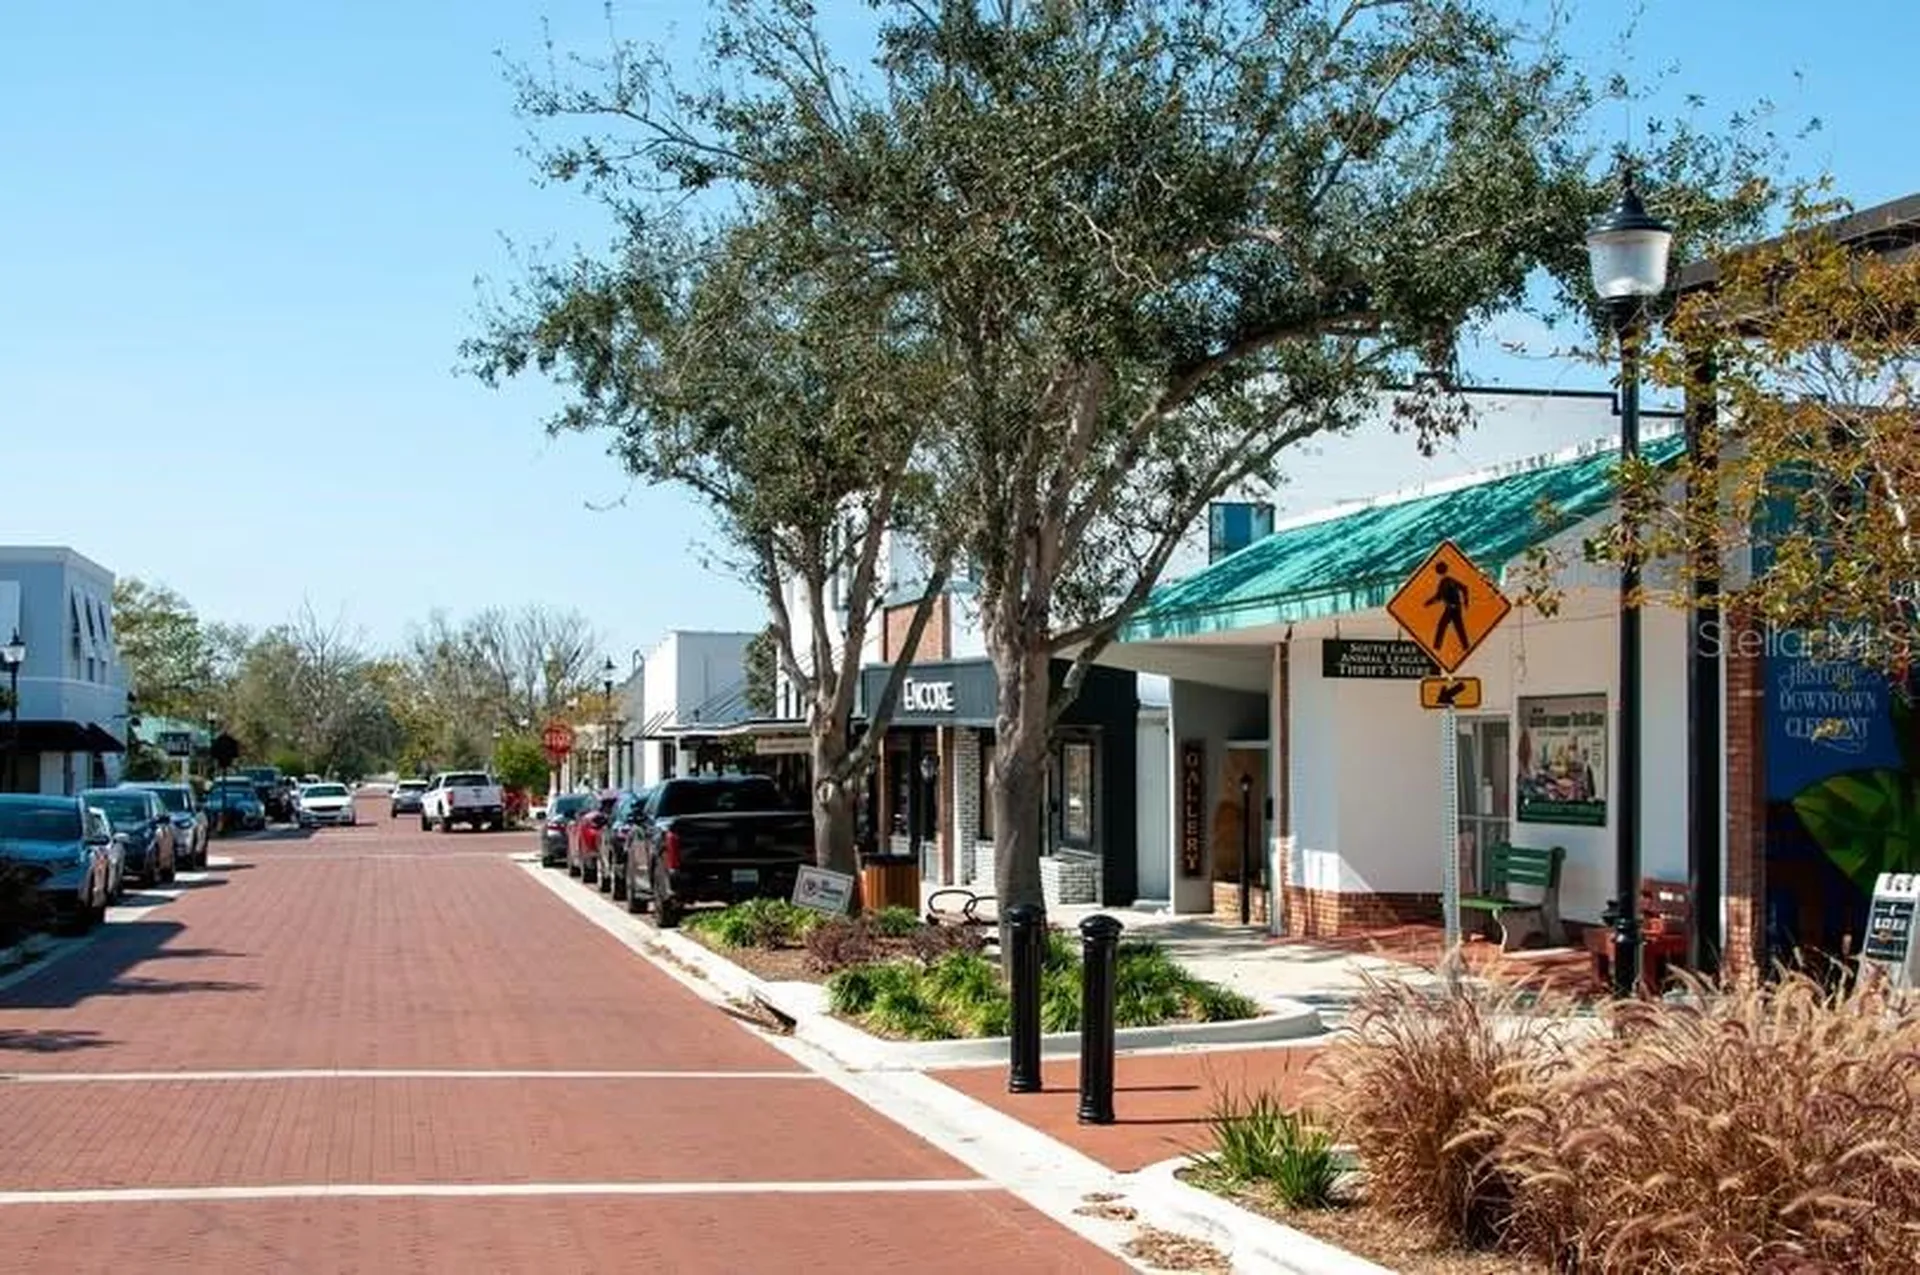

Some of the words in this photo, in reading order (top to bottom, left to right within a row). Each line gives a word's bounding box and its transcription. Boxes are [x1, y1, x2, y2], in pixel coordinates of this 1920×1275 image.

[903, 677, 956, 712] ENCORE
[1780, 691, 1877, 713] DOWNTOWN
[544, 731, 572, 748] STOP
[1186, 753, 1199, 870] GALLERY
